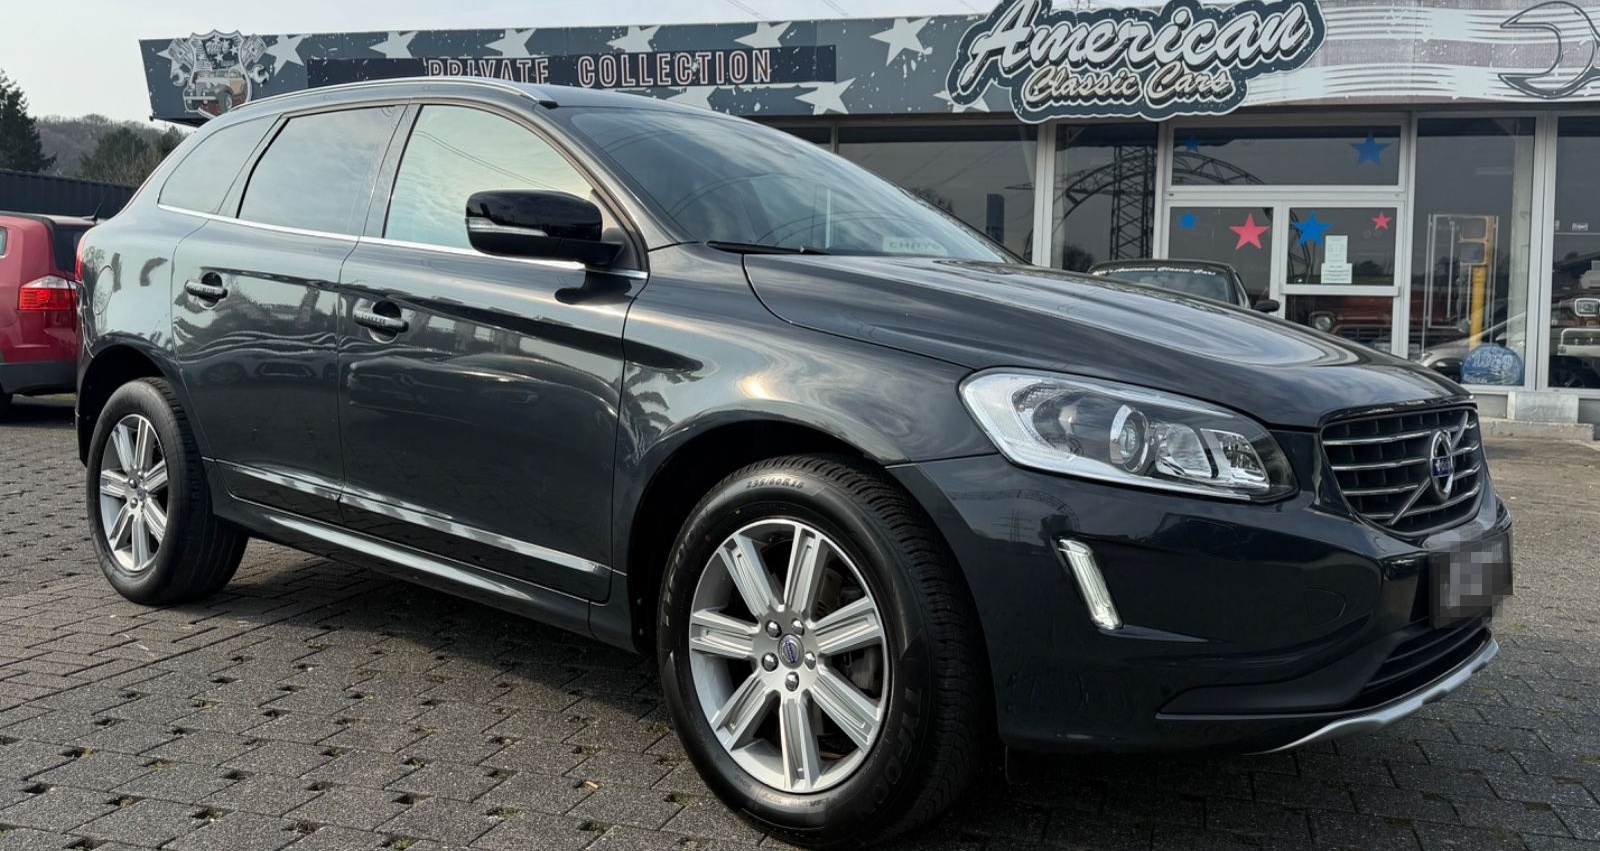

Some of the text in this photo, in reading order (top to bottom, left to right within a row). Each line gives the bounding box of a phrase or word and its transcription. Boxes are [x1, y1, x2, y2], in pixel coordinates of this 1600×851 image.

[959, 0, 1312, 88] American
[427, 50, 771, 88] PRIVATE COLLECTION
[1026, 61, 1234, 104] Classic Cars
